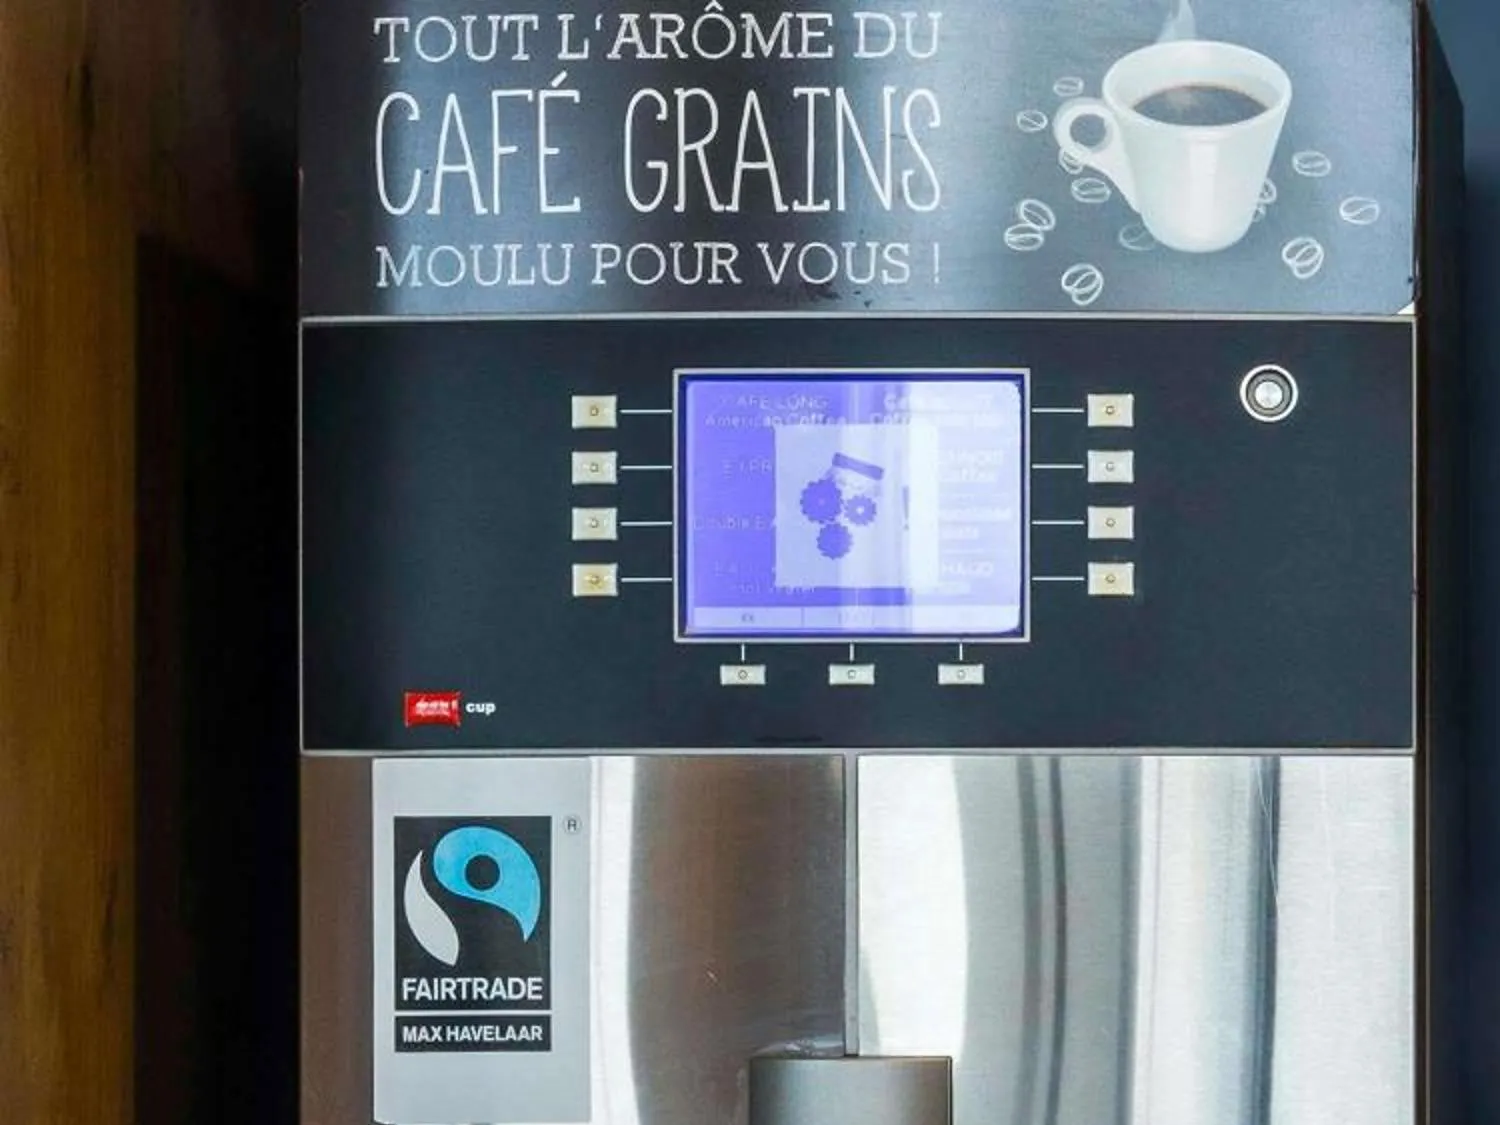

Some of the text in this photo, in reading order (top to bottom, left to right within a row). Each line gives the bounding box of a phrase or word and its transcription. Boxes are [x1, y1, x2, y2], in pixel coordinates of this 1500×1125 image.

[373, 14, 539, 63] TOUT
[853, 11, 942, 58] DU
[374, 71, 942, 215] CAFÉ GRAINS
[375, 243, 574, 287] MOULU
[591, 242, 742, 285] POUR
[757, 242, 911, 285] VOUS
[465, 702, 497, 716] cup
[402, 977, 543, 1001] FAIRTRADE
[402, 1025, 543, 1042] MAX HAVELAAR
